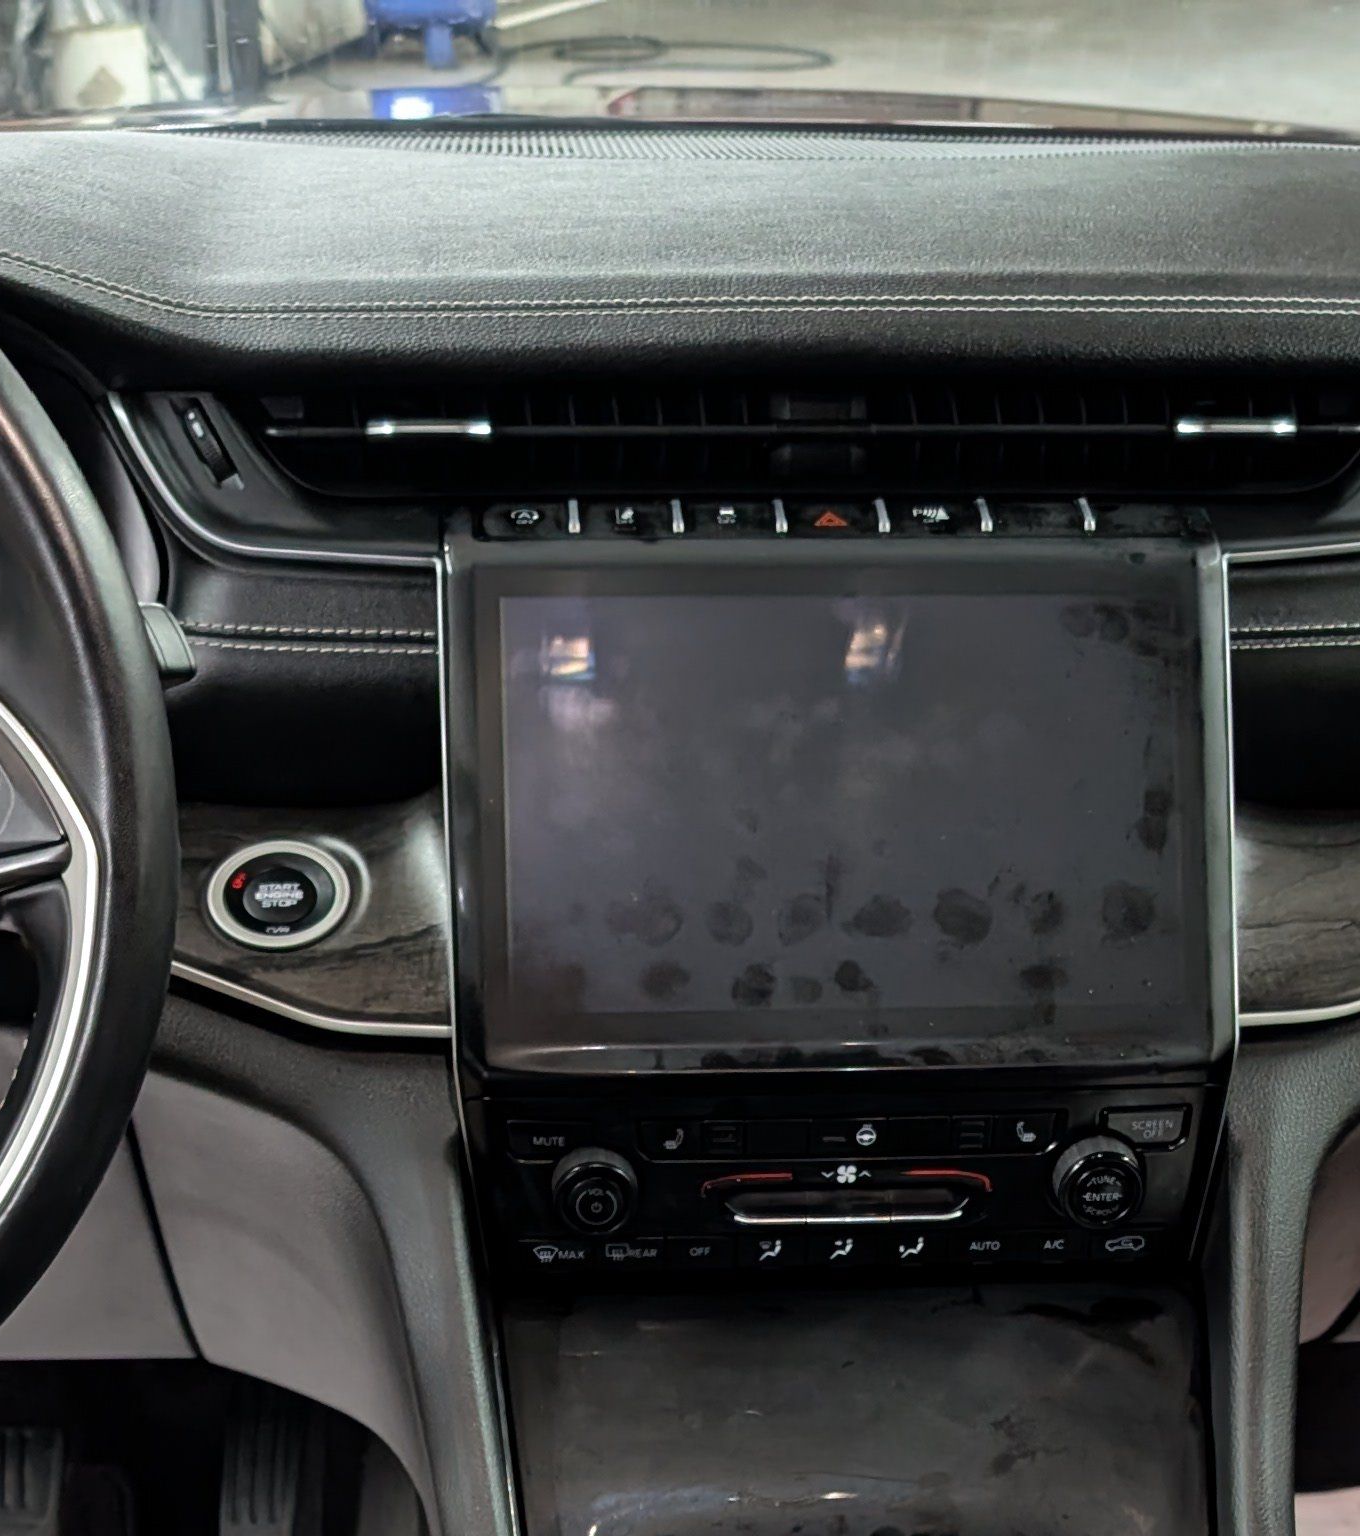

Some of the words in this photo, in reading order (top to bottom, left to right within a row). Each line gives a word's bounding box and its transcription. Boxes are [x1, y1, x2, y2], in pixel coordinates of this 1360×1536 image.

[259, 883, 300, 891] START
[255, 891, 303, 900] ENGINE
[262, 900, 298, 908] STOP
[1131, 1119, 1175, 1131] SCREEN
[533, 1135, 566, 1147] MUTE
[1085, 1192, 1120, 1202] ENTER
[969, 1241, 1001, 1251] AUTO
[1043, 1239, 1065, 1250] A/C
[558, 1249, 586, 1260] MAX
[689, 1246, 712, 1257] OFF
